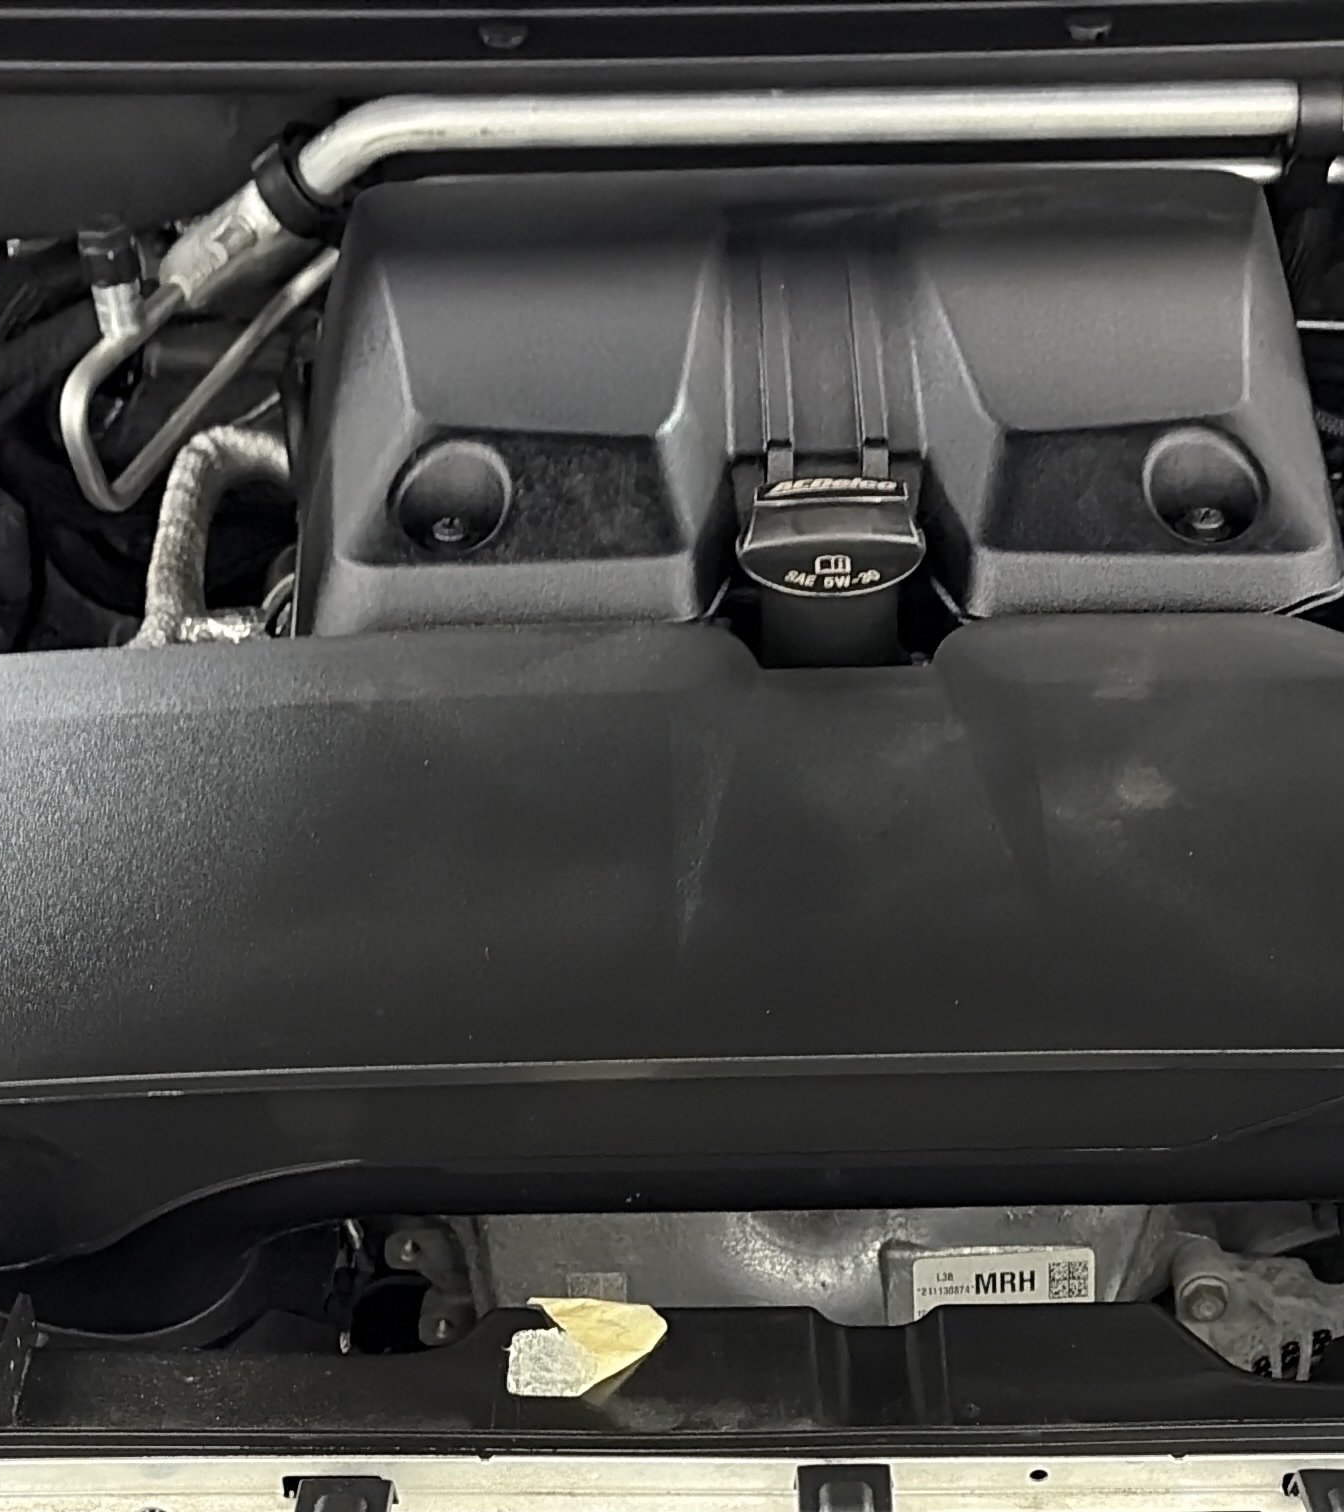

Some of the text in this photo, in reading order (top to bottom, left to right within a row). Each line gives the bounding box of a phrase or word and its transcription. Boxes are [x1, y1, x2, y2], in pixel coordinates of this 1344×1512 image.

[764, 477, 898, 498] ACDelco
[784, 569, 816, 588] SAE
[975, 1270, 1036, 1295] MRH
